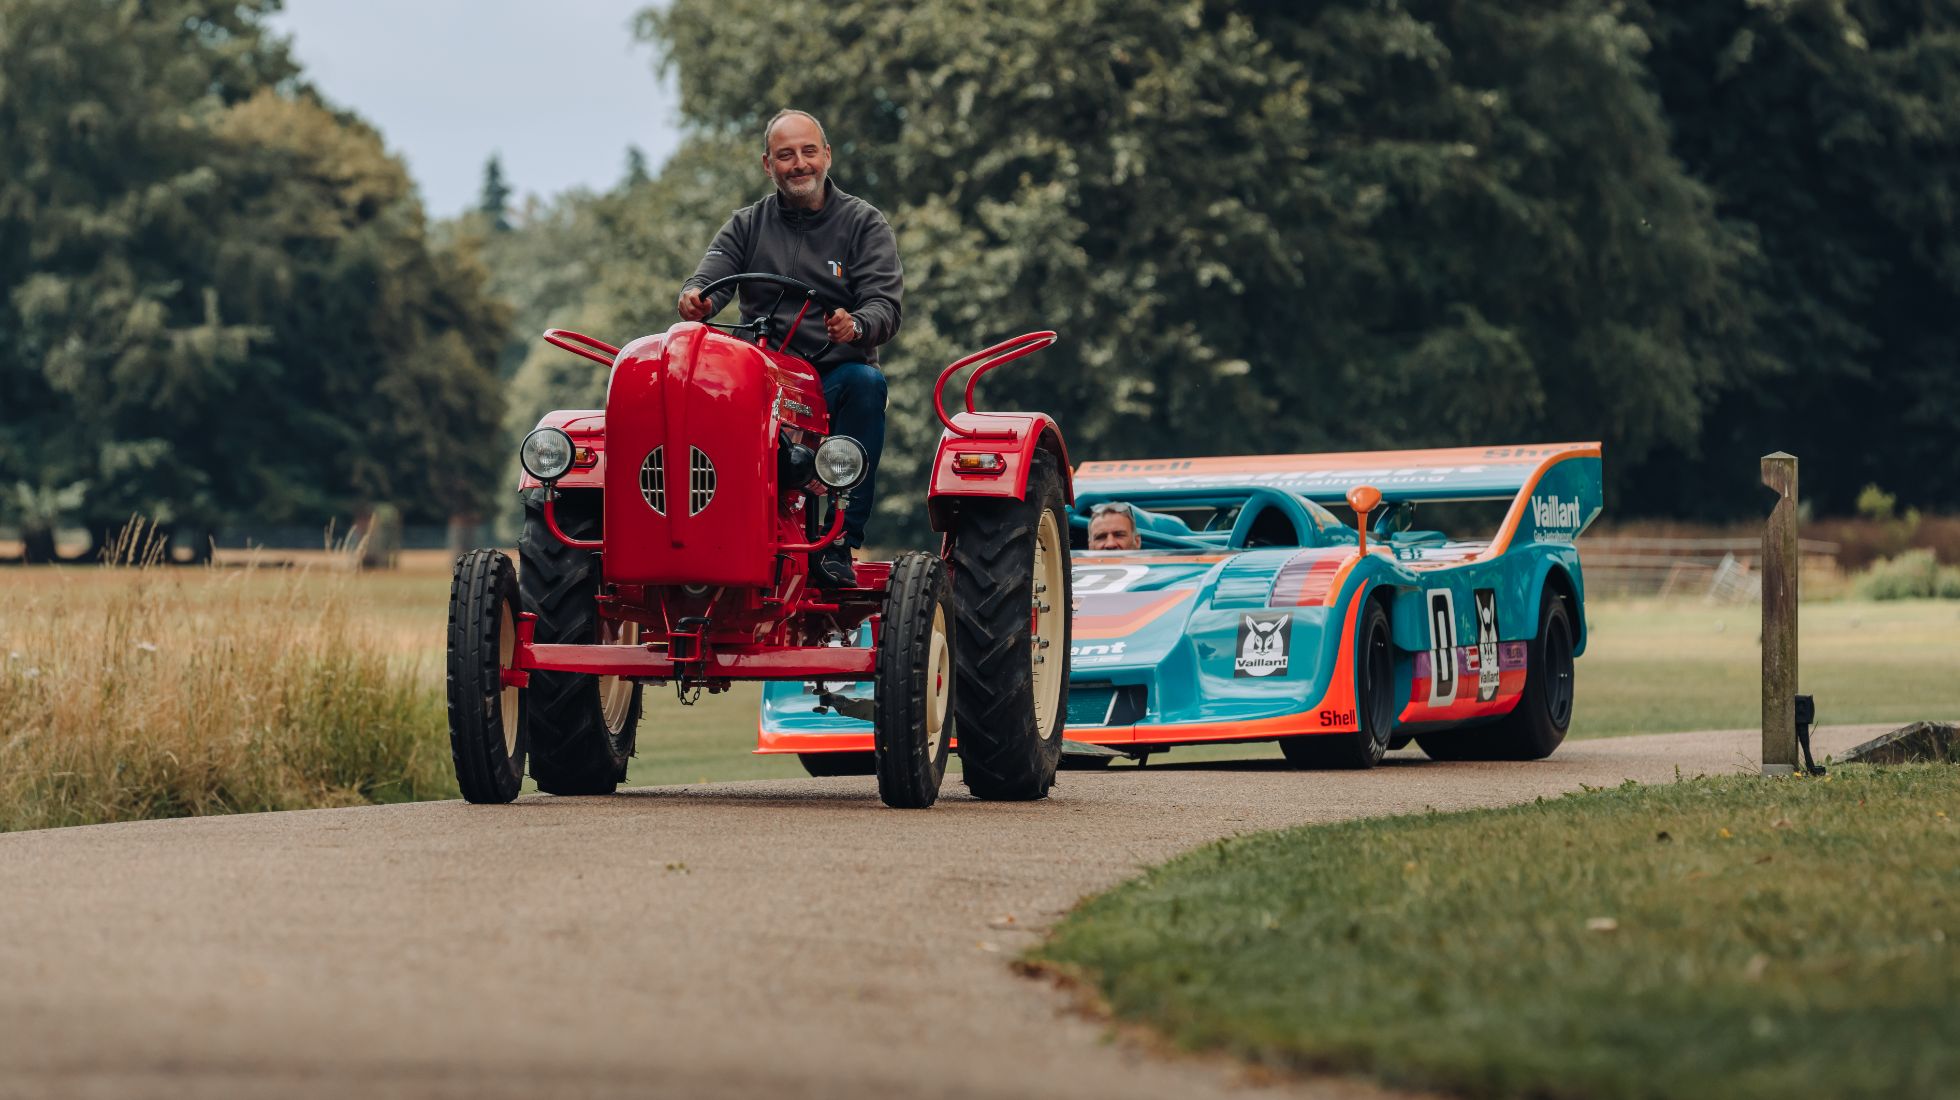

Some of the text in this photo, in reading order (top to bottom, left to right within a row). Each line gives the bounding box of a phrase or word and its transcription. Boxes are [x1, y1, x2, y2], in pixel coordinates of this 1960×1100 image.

[1531, 495, 1580, 528] Vaillant
[1237, 658, 1287, 668] Vaillant
[1320, 709, 1356, 727] Shell
